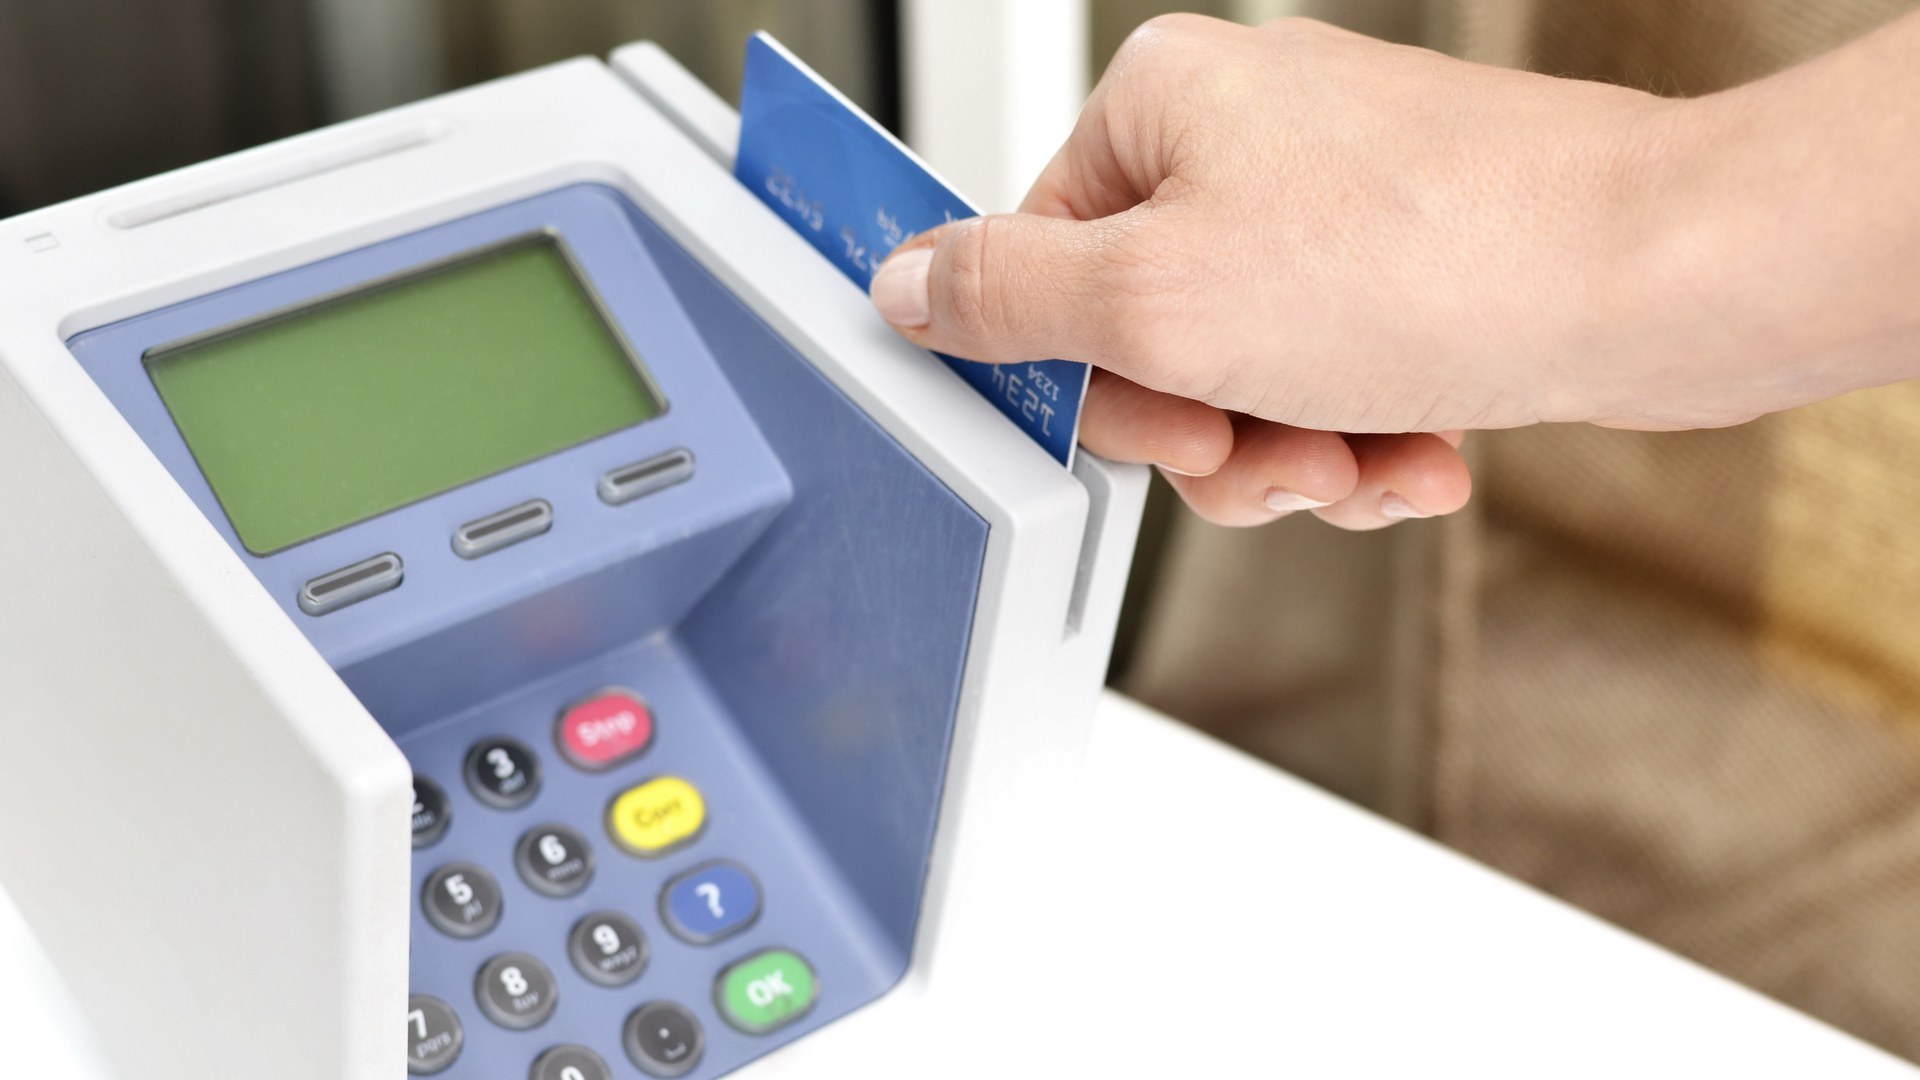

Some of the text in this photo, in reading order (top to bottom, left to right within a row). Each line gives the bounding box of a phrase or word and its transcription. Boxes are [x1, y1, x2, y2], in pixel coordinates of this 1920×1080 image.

[991, 364, 1056, 437] 1234
[486, 747, 516, 779] 3
[539, 834, 567, 865] 6
[444, 874, 474, 905] 5
[592, 924, 621, 955] 9
[500, 966, 528, 996] 8
[746, 969, 794, 1006] OK
